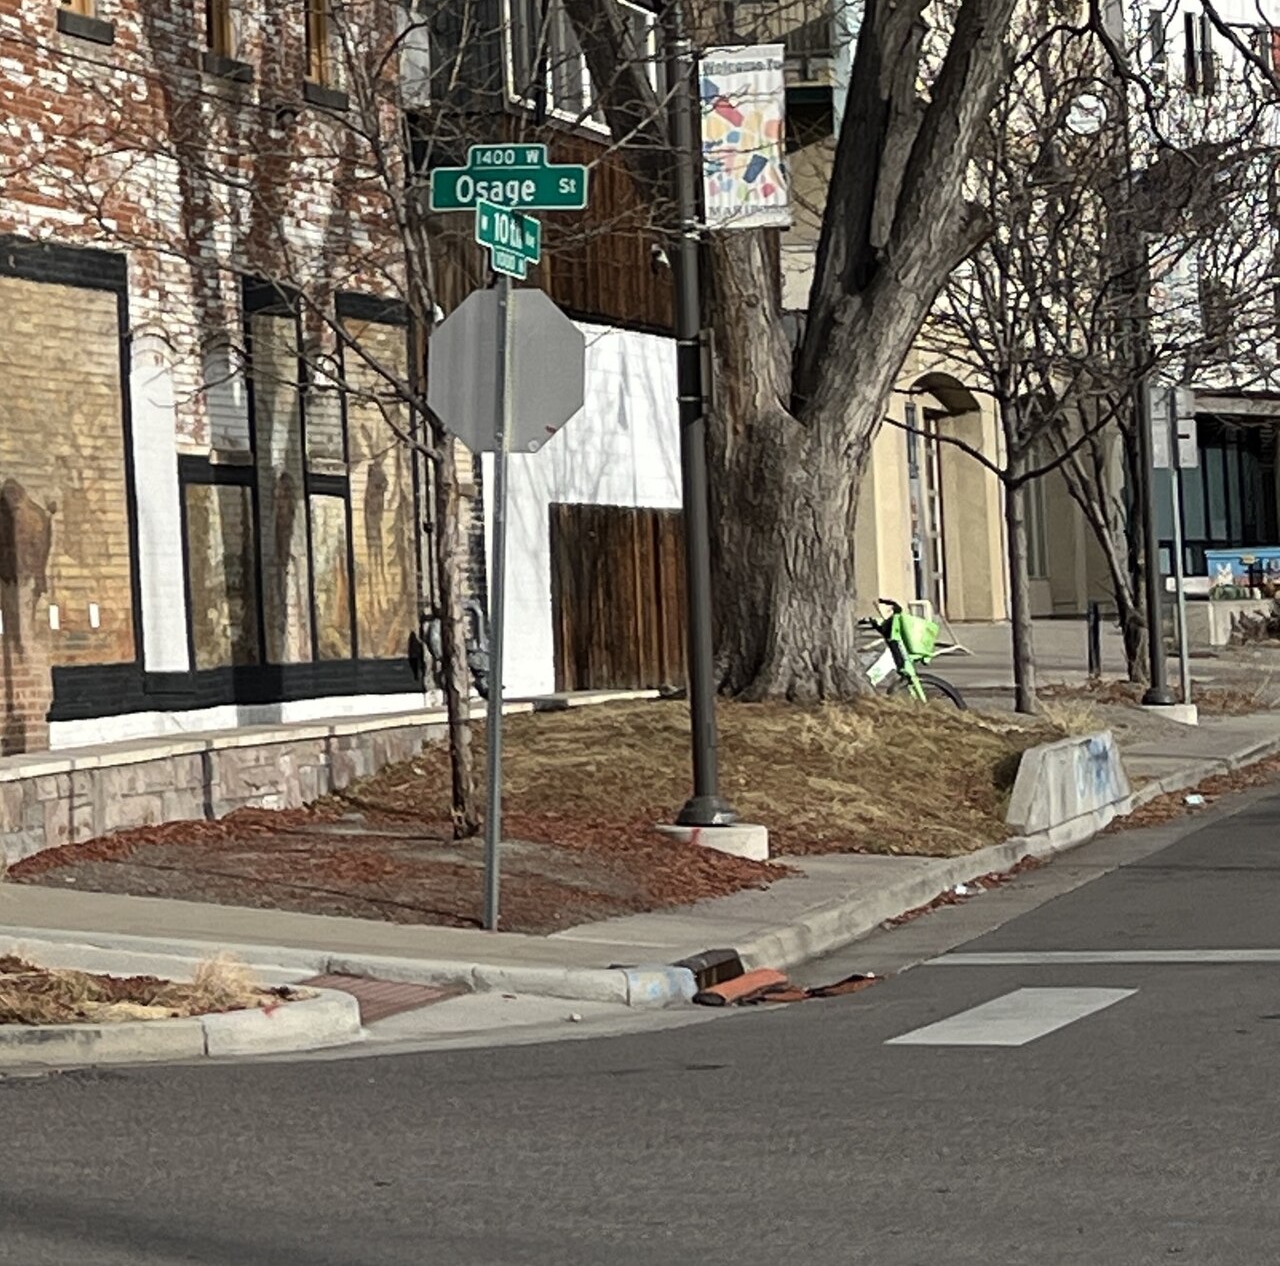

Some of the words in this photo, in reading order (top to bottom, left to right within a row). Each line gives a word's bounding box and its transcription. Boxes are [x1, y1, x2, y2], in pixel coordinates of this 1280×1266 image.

[475, 149, 516, 165] 1400
[526, 149, 540, 164] W
[455, 174, 537, 205] Osage
[558, 177, 577, 194] St
